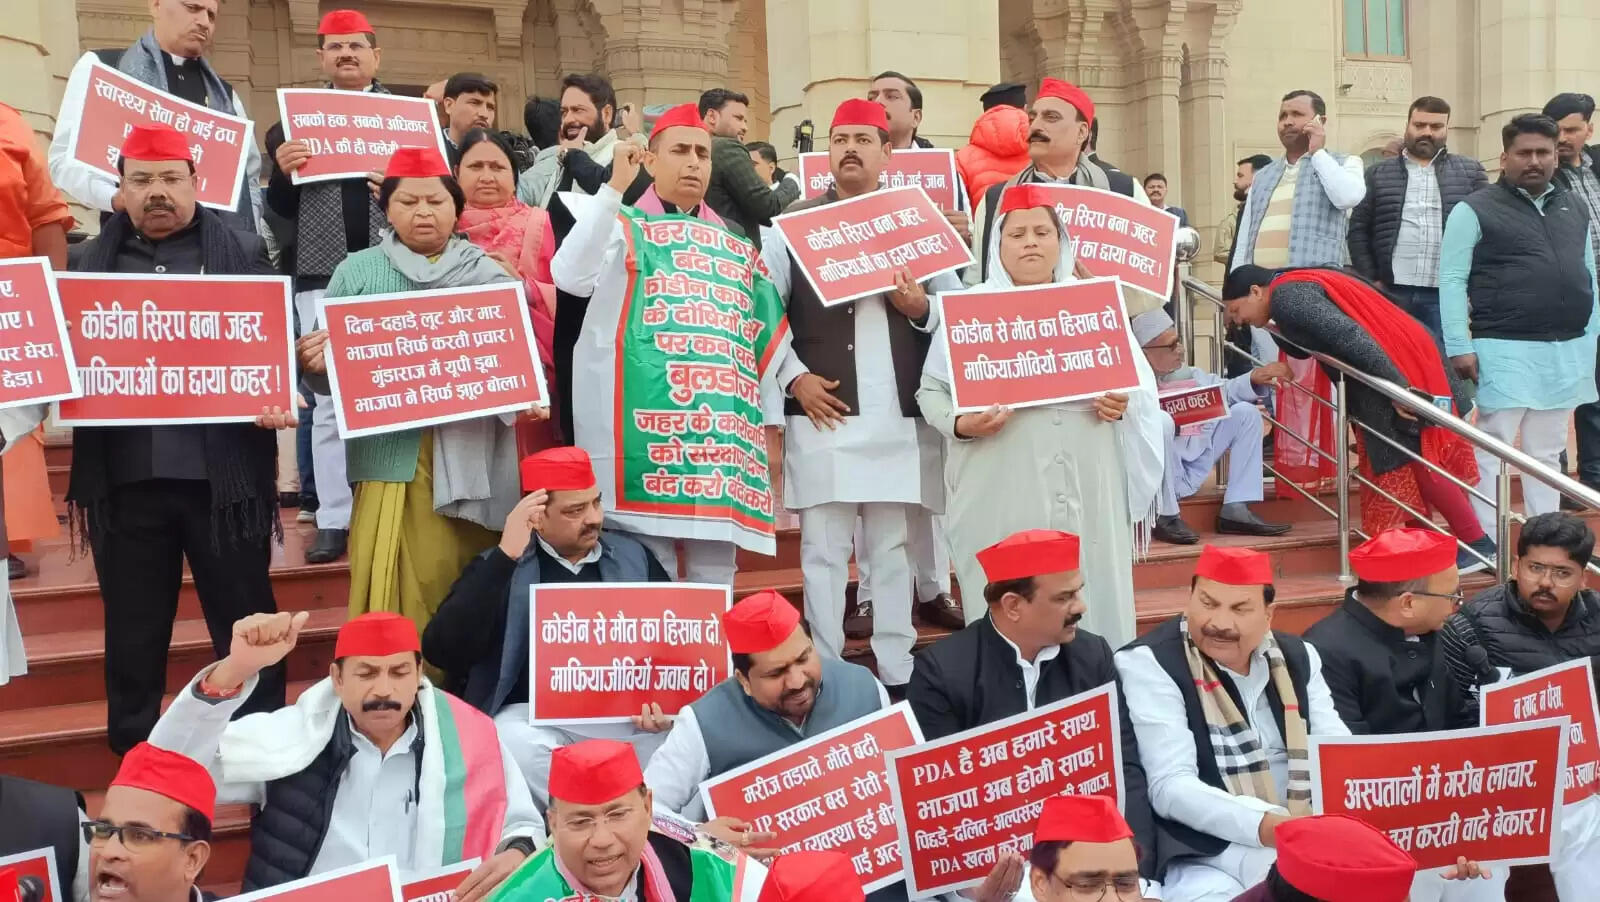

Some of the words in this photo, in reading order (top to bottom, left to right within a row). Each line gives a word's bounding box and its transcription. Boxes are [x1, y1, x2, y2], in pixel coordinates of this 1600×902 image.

[175, 111, 190, 132] हो
[192, 119, 214, 141] गई
[335, 138, 351, 154] की
[353, 140, 367, 156] ही
[690, 224, 719, 248] का
[871, 215, 897, 234] बना
[1108, 215, 1129, 235] बना
[674, 247, 711, 273] बंद
[872, 254, 892, 270] का
[1081, 240, 1100, 259] का
[81, 301, 138, 340] कोडीन
[141, 300, 185, 342] सिरप
[189, 311, 220, 340] बना
[421, 311, 444, 330] लूट
[448, 305, 475, 325] और
[644, 300, 667, 324] के
[674, 301, 741, 333] दोषियों
[950, 317, 994, 345] कोडीन
[996, 316, 1009, 343] से
[1010, 314, 1037, 341] मौत
[1038, 317, 1058, 338] का
[1058, 309, 1100, 337] हिसाब
[346, 343, 393, 361] भाजपा
[396, 335, 429, 356] सिर्फ
[432, 330, 470, 350] करती
[472, 329, 508, 347] प्रचार
[655, 334, 689, 352] पर
[693, 335, 730, 357] कब
[161, 366, 184, 395] का
[230, 365, 272, 396] कहर
[370, 365, 425, 389] गुंडाराज
[428, 359, 441, 376] में
[445, 358, 471, 379] यूपी
[963, 349, 1058, 381] माफियाजीवियों
[1058, 349, 1095, 373] जवाब
[355, 395, 401, 413] भाजपा
[404, 390, 418, 405] ने
[420, 383, 453, 404] सिर्फ
[487, 375, 519, 394] बोला
[635, 410, 687, 434] जहर
[690, 405, 712, 432] के
[649, 437, 683, 463] को
[688, 439, 745, 470] संरक्षण
[644, 469, 679, 494] बंद
[684, 468, 723, 496] करो
[746, 487, 773, 514] करो
[542, 611, 590, 644] कोडीन
[593, 611, 606, 645] से
[610, 611, 638, 644] मौत
[641, 618, 660, 643] का
[663, 609, 702, 646] हिसाब
[550, 656, 652, 693] माफियाजीवियों
[654, 665, 692, 692] जवाब
[912, 760, 955, 787] PDA
[958, 747, 974, 775] है
[978, 741, 1008, 768] अब
[1011, 721, 1059, 758] हमारे
[742, 773, 782, 804] मरीज
[775, 797, 826, 832] सरकार
[824, 786, 848, 811] बस
[851, 770, 883, 801] रोती
[917, 787, 980, 820] भाजपा
[982, 775, 1013, 803] अब
[1015, 759, 1055, 794] होगी
[1344, 765, 1423, 811] अस्पतालों
[1425, 763, 1441, 800] में
[1444, 761, 1486, 798] गरीब
[854, 808, 877, 840] हुई
[1416, 811, 1462, 849] करती
[1463, 807, 1490, 842] वादे
[1492, 805, 1538, 838] बेकार
[930, 856, 964, 876] PDA
